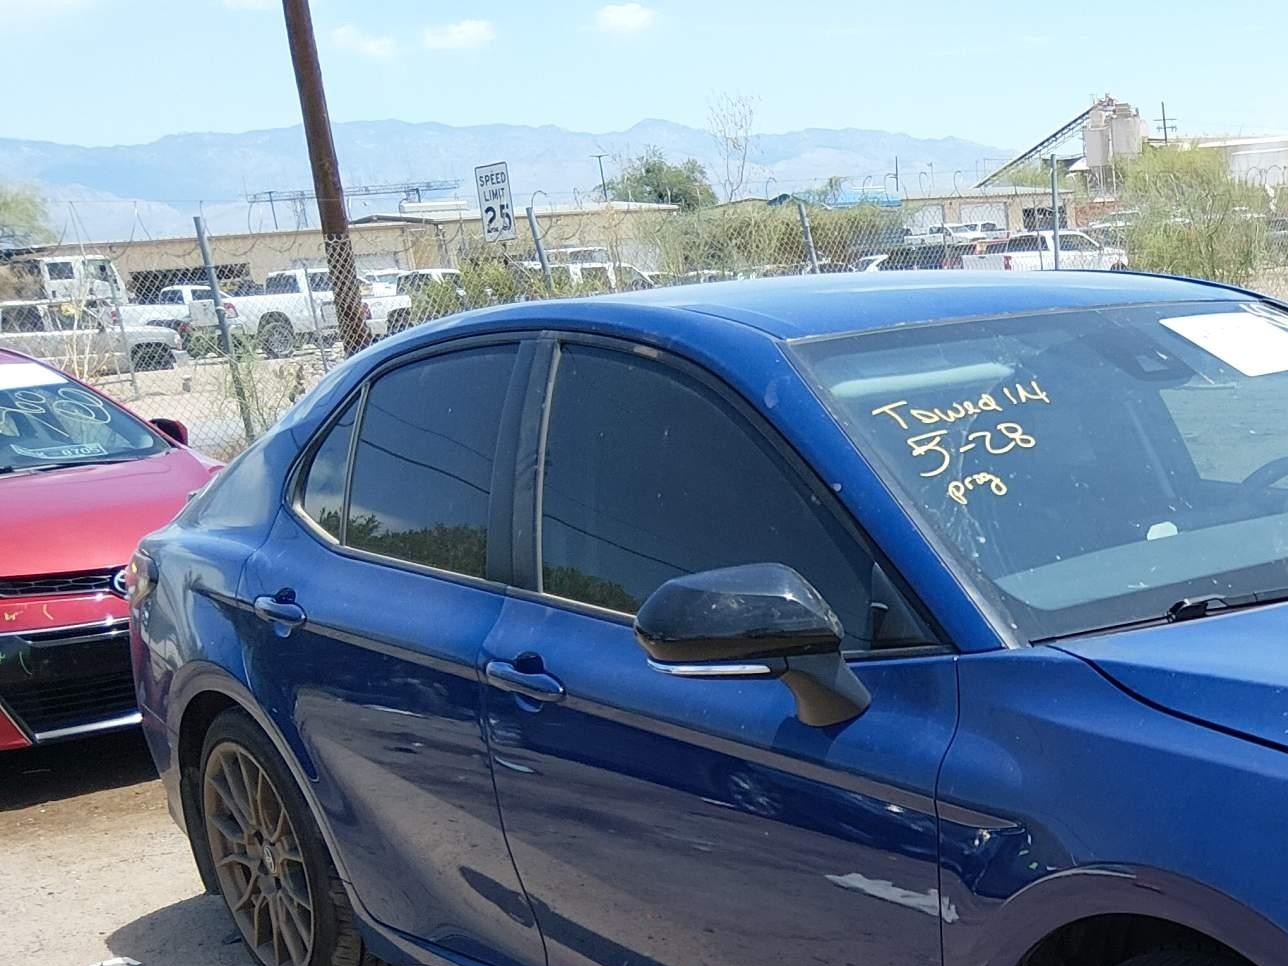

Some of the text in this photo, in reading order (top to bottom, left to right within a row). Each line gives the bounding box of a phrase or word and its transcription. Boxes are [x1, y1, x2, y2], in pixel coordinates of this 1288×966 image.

[479, 172, 506, 187] SPEED
[483, 188, 505, 202] LIMIT
[484, 204, 512, 233] 25
[872, 380, 1050, 430] Towed IN
[906, 422, 1037, 478] 5-28
